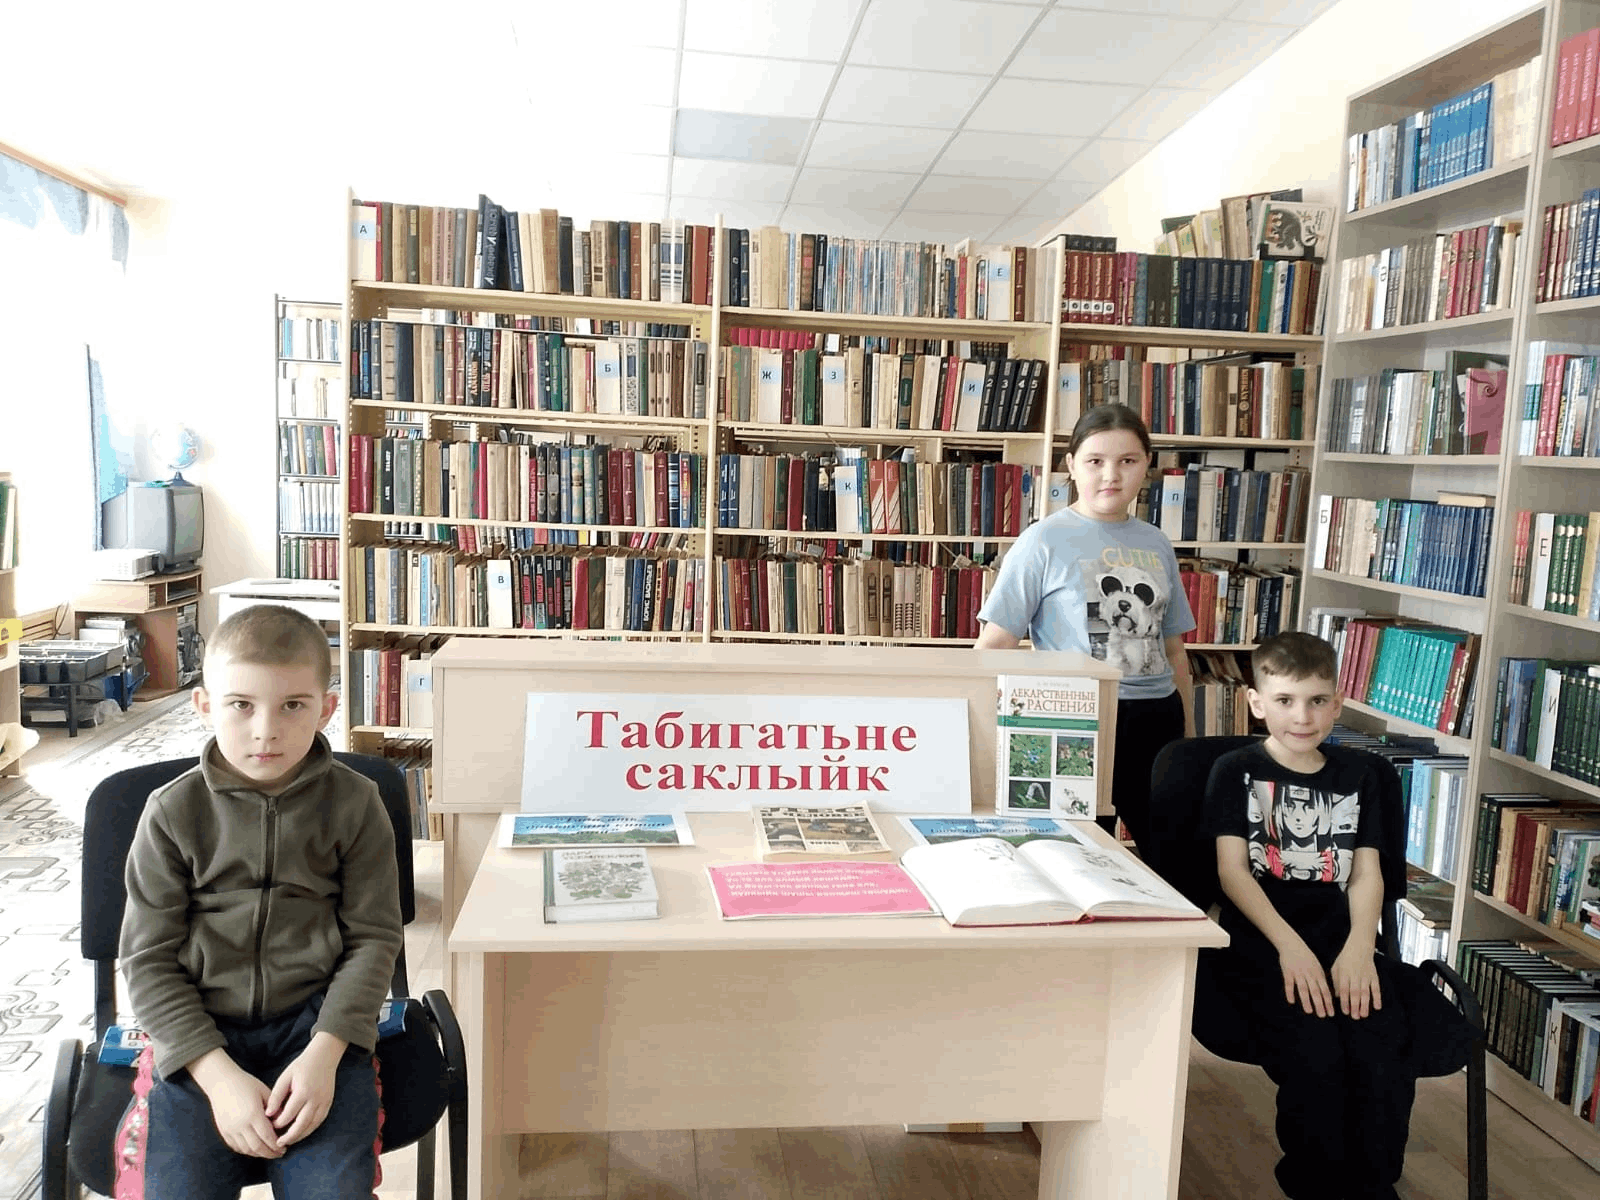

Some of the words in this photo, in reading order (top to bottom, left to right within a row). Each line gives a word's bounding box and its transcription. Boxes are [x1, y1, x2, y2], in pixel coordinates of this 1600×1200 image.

[359, 224, 368, 235] А
[996, 266, 1003, 277] Е
[604, 363, 612, 373] Б
[762, 370, 772, 380] Ж
[968, 383, 975, 393] И
[986, 378, 994, 388] 2
[1001, 379, 1009, 389] 3
[1018, 379, 1025, 388] 4
[1030, 379, 1038, 389] 5
[1062, 380, 1069, 389] Н
[845, 482, 852, 491] К
[1051, 488, 1060, 498] О
[1172, 493, 1179, 502] П
[1320, 509, 1328, 524] Б
[1540, 537, 1549, 557] Е
[498, 575, 505, 584] В
[419, 676, 425, 687] Г
[1010, 687, 1096, 701] ЛЕКАРСТВЕННЫЕ
[1027, 698, 1096, 714] РАСТЕНИЯ
[1548, 695, 1557, 715] И
[576, 710, 917, 752] Табигатьне
[625, 754, 891, 791] саклыйк
[1550, 1022, 1557, 1045] К
